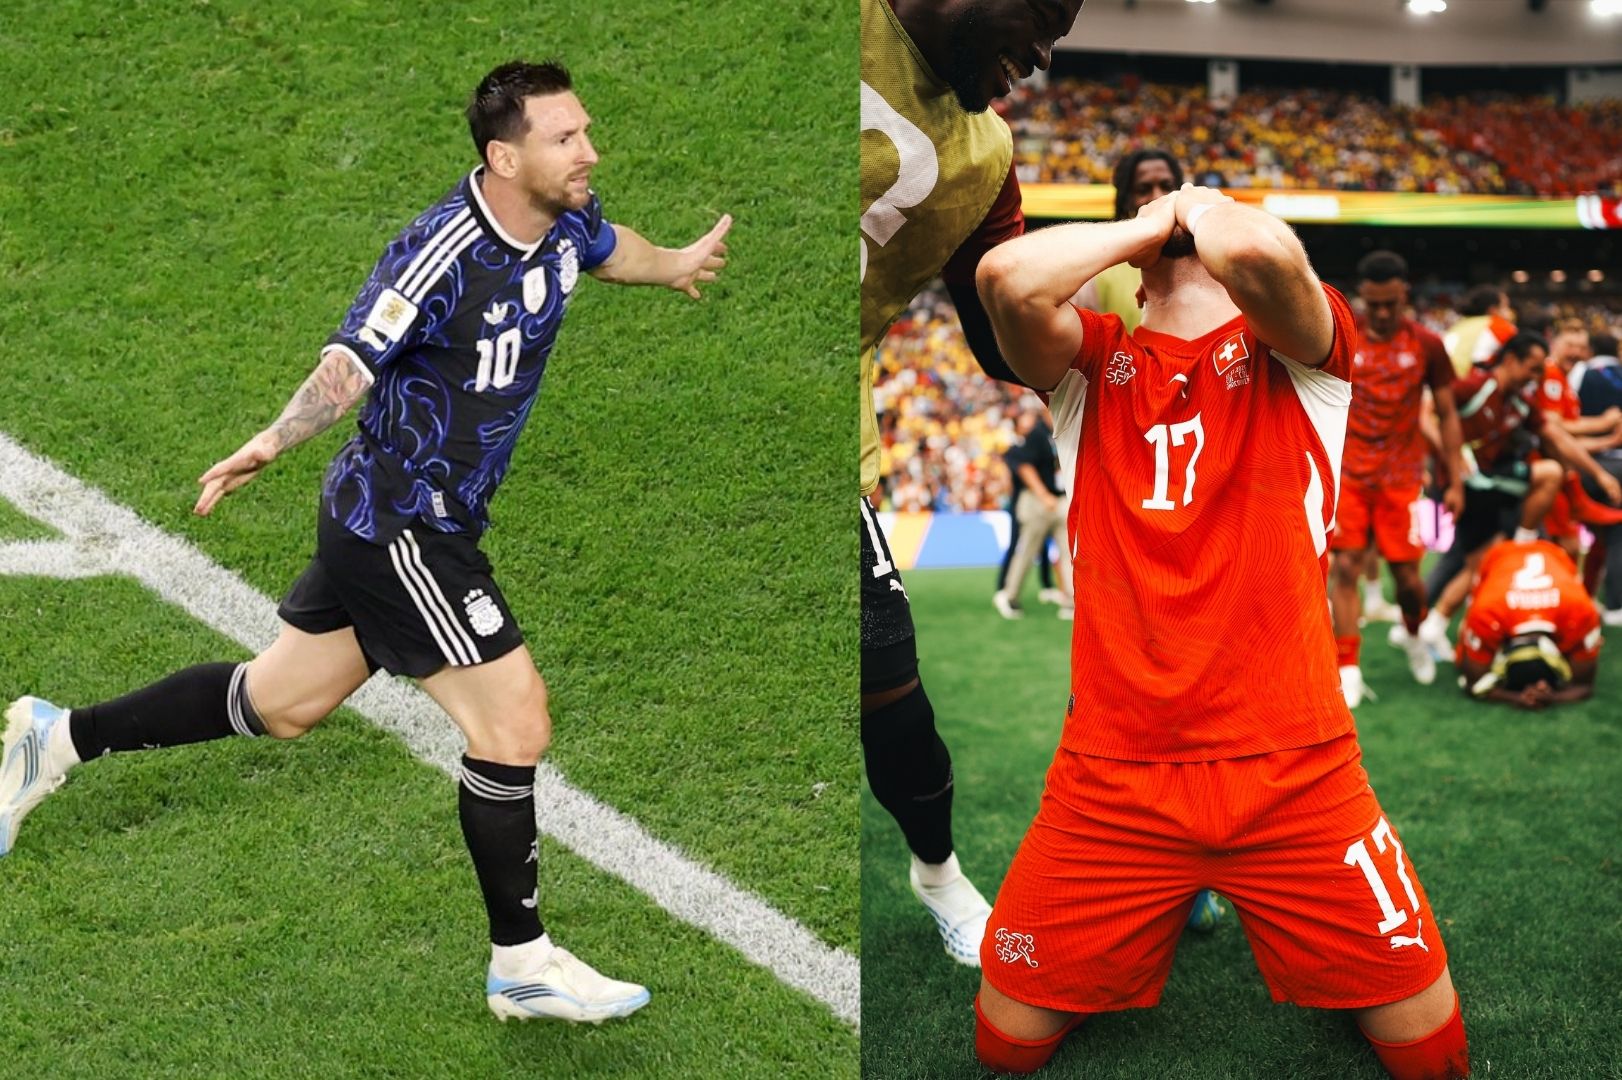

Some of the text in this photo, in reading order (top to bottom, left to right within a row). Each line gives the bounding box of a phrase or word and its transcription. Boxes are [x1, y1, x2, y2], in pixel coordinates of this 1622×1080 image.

[475, 327, 522, 393] 10
[1142, 411, 1205, 511] 17
[860, 495, 893, 579] 1
[1344, 816, 1421, 935] 17
